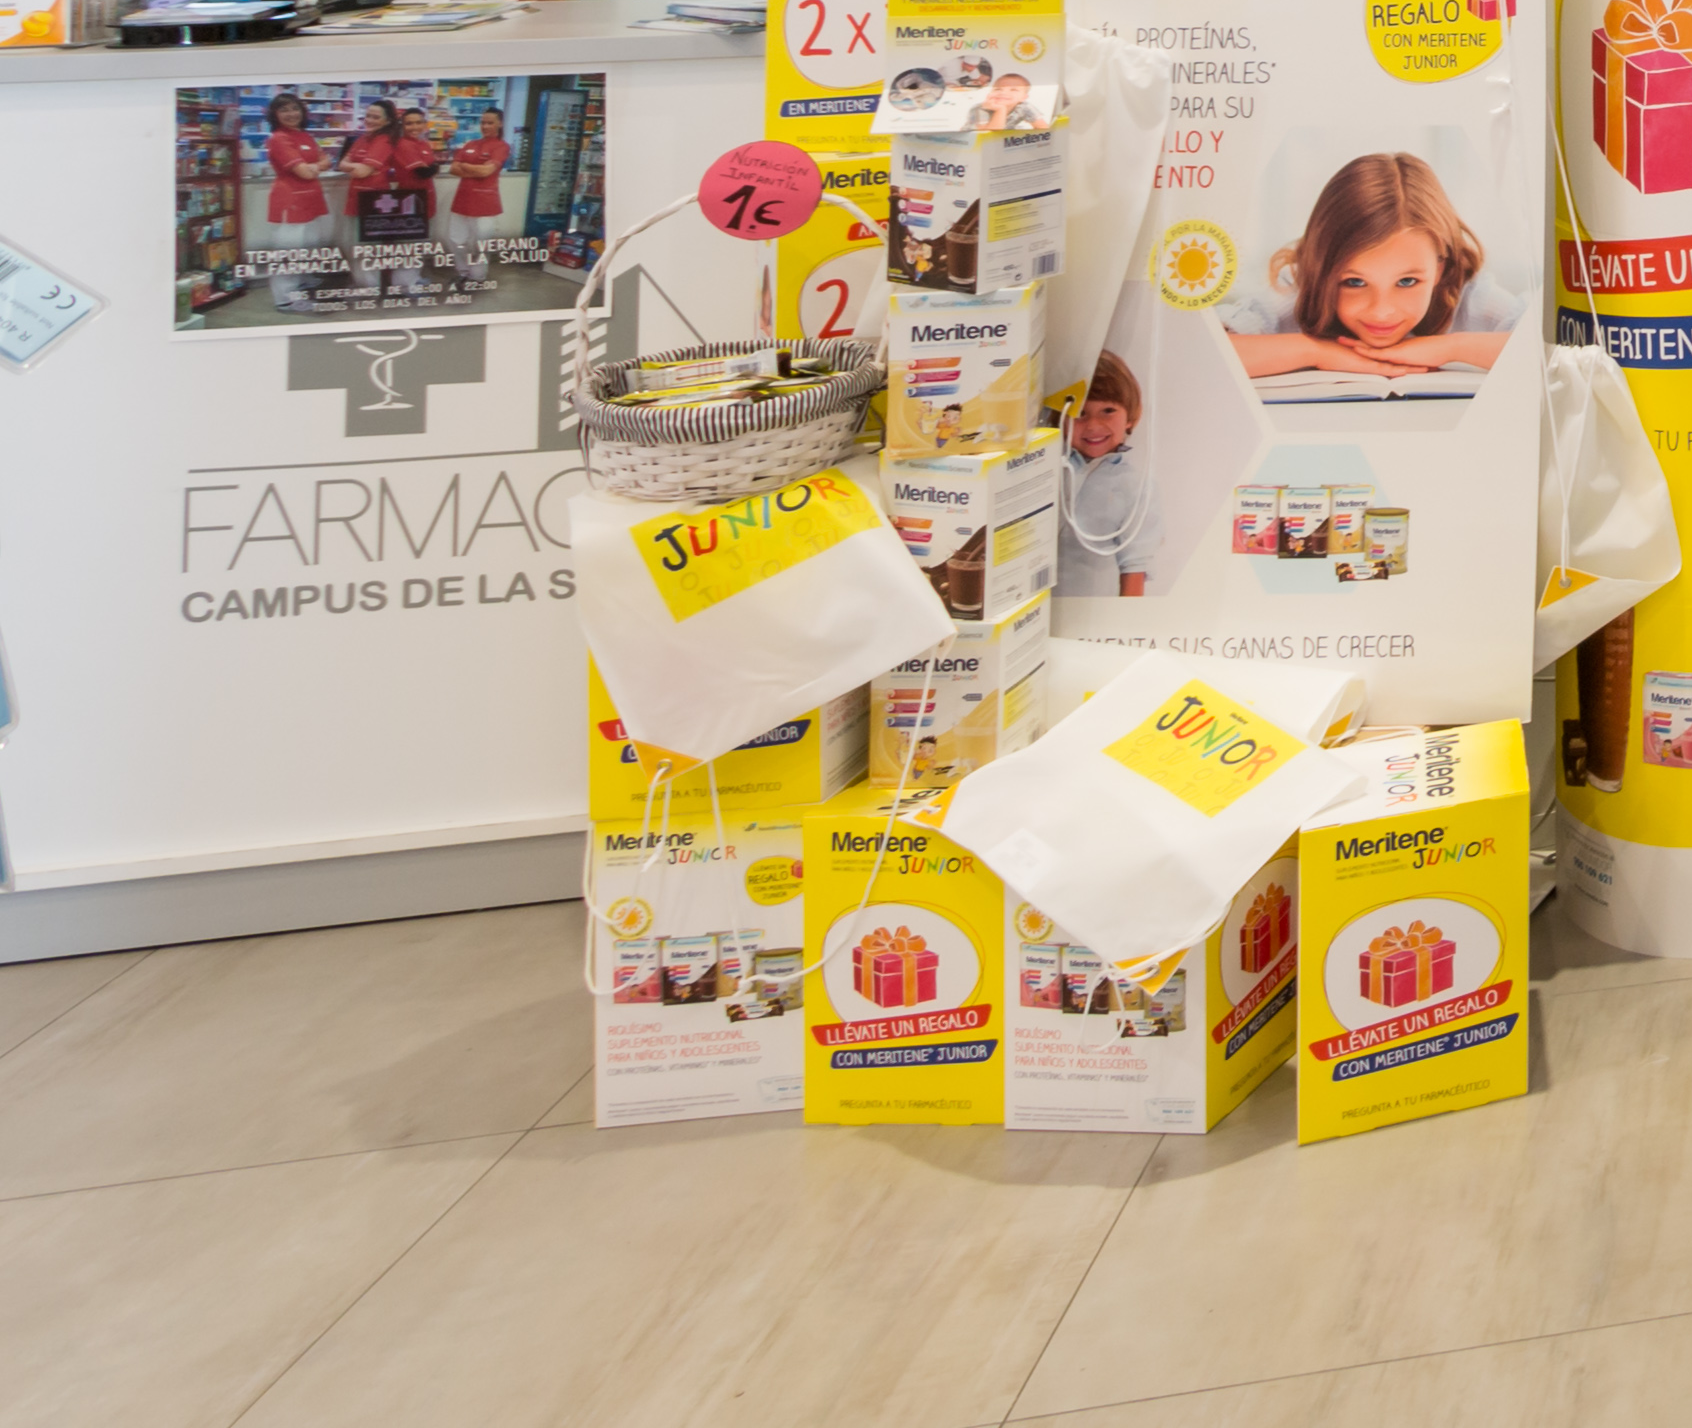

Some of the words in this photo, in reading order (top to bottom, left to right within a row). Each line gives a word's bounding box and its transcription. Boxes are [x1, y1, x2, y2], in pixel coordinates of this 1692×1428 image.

[1372, 1, 1460, 28] REGALO
[1383, 34, 1412, 48] CON
[1417, 32, 1487, 48] MERITENE
[1403, 54, 1457, 70] JUNIOR
[234, 264, 254, 278] EN
[266, 258, 349, 276] FARMACIA
[362, 254, 424, 271] CAMPUS
[433, 253, 455, 267] DE
[467, 250, 488, 265] LA
[498, 248, 549, 263] SALUD
[246, 246, 337, 264] TEMPORADA
[353, 242, 444, 260] PRIMAVERA
[477, 237, 539, 252] VERANO
[1571, 252, 1656, 288] LLÉVATE
[912, 322, 1008, 343] Meritene
[1655, 429, 1679, 451] TU
[180, 466, 601, 573] FARMAC
[654, 476, 851, 571] JUNIOR
[182, 581, 387, 623] CAMPUS
[402, 577, 465, 610] DE
[477, 573, 536, 604] LA
[1221, 637, 1295, 659] GANAS
[1303, 636, 1328, 659] DE
[1334, 635, 1415, 659] CRECER
[1335, 827, 1444, 861] Meritene
[1413, 837, 1496, 869] JUNIOR
